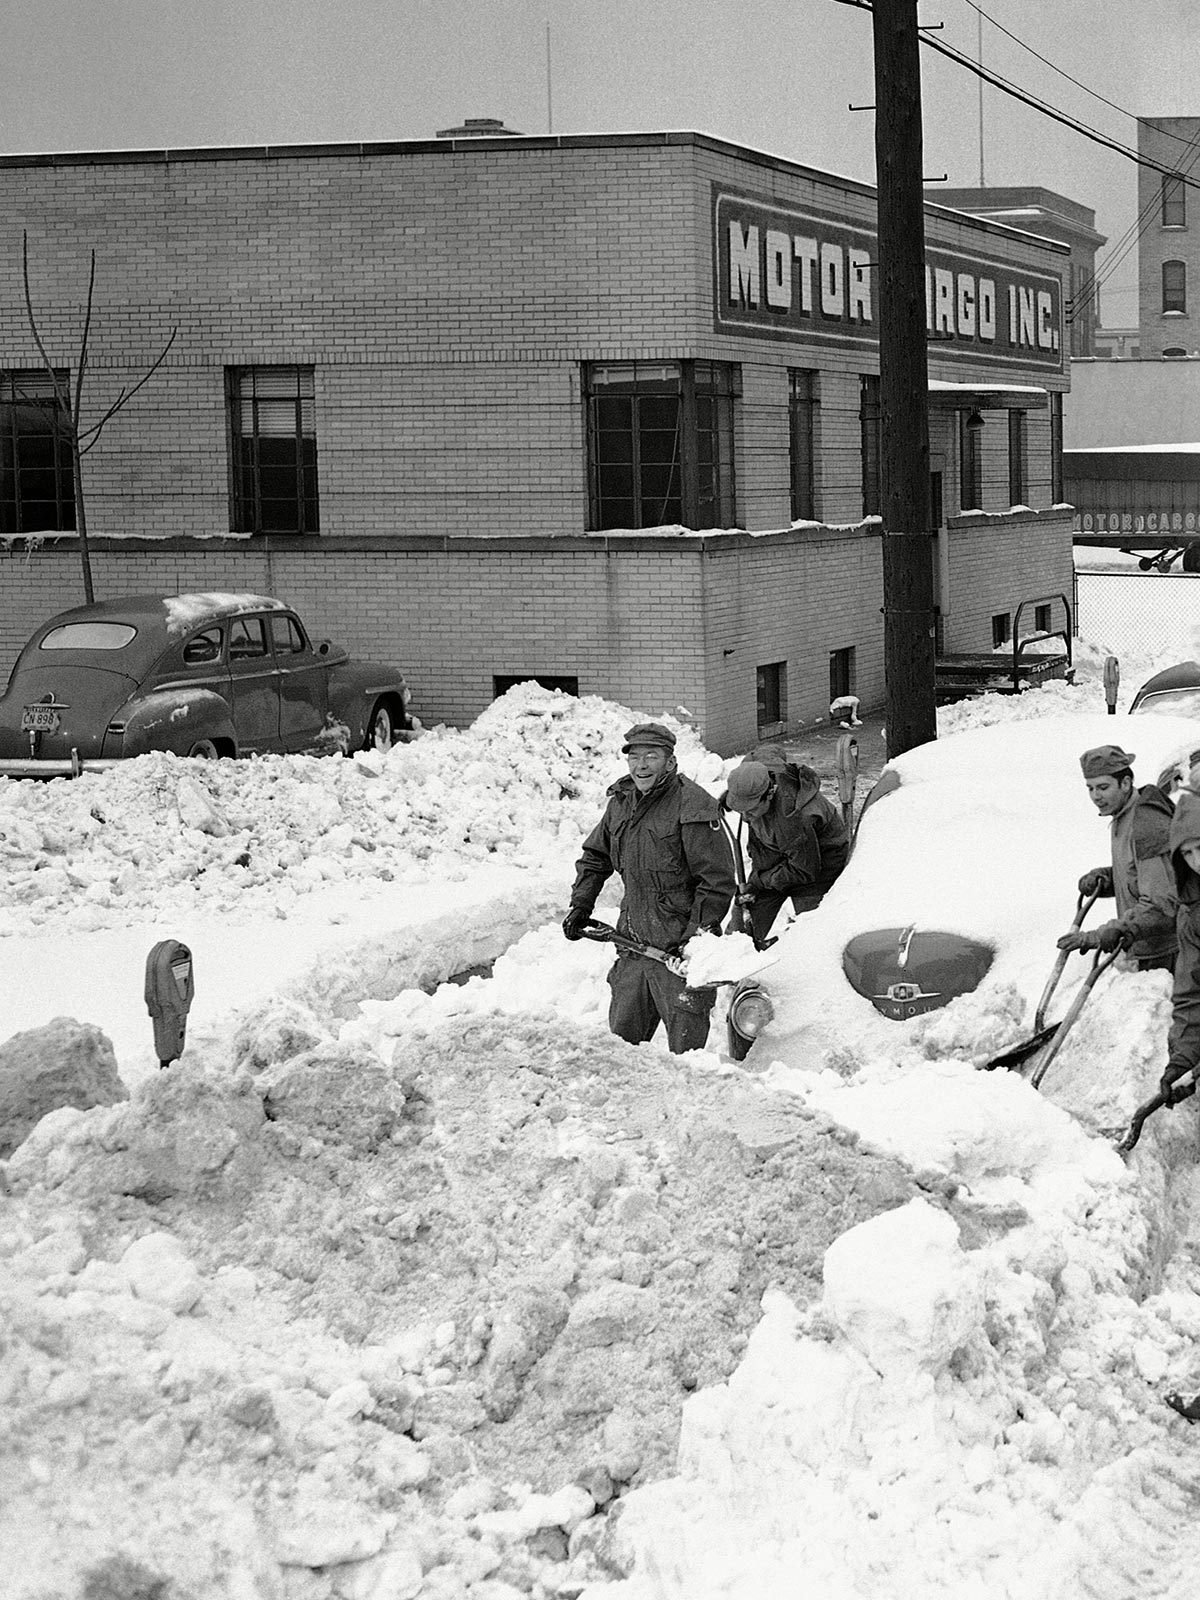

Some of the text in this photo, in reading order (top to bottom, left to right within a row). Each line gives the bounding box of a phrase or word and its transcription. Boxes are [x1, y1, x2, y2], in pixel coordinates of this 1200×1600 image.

[729, 220, 873, 322] MOTOR
[1008, 284, 1059, 350] INC.
[1072, 513, 1132, 531] MOTOR
